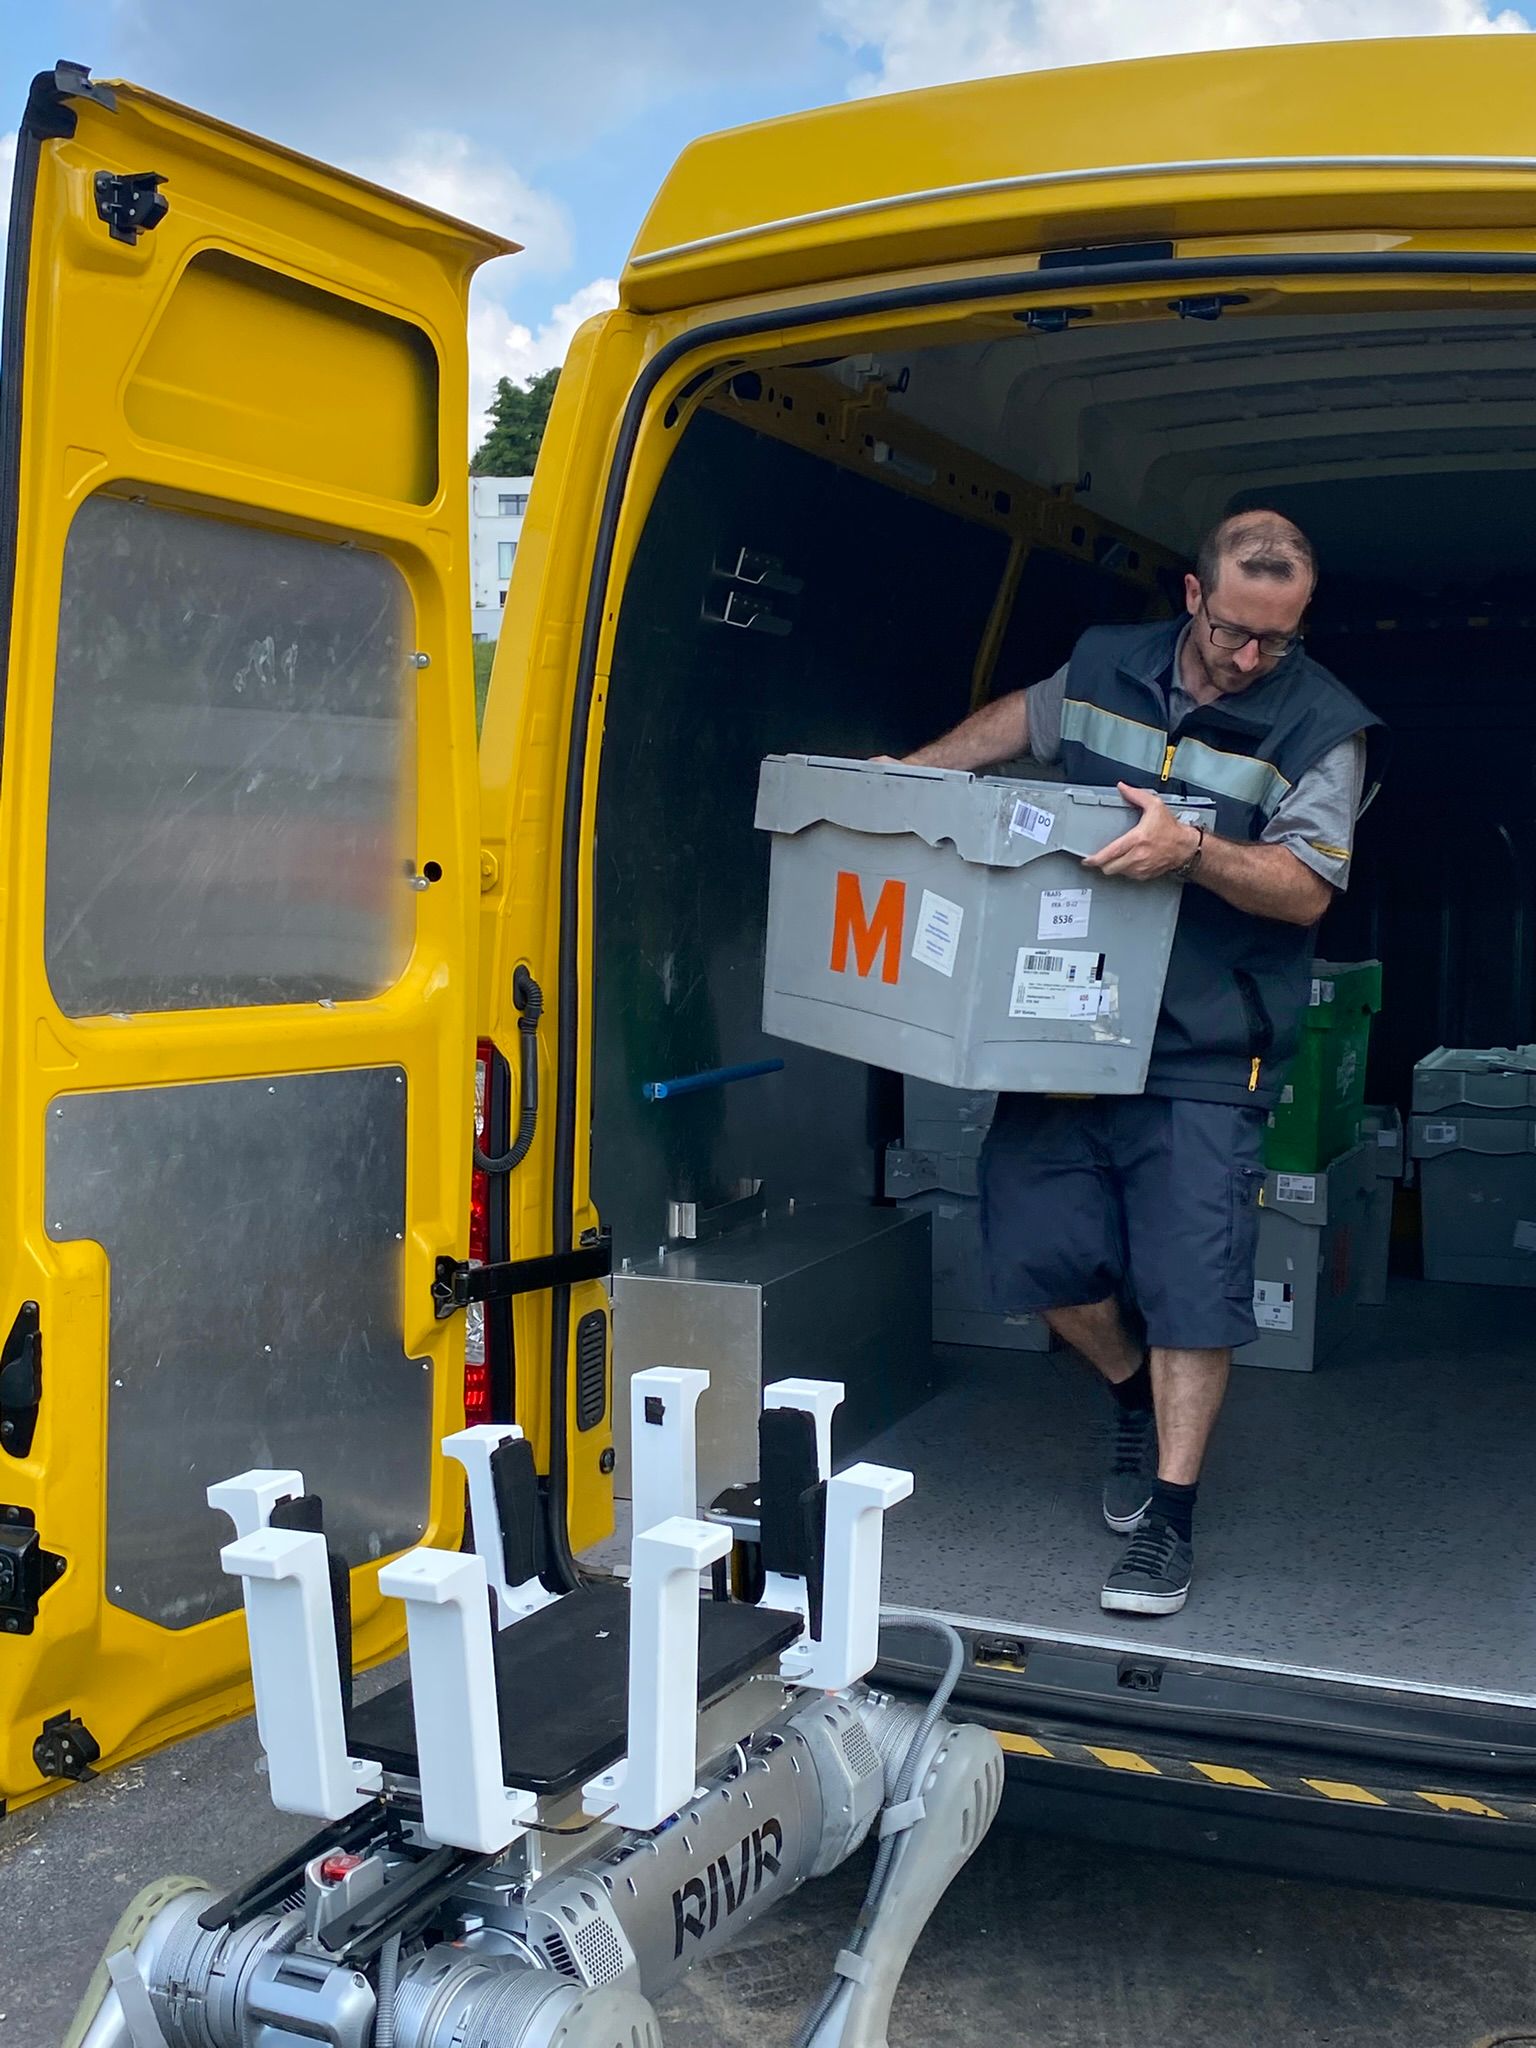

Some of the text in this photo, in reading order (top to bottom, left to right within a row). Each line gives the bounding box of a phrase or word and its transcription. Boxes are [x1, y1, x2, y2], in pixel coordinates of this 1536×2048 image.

[1038, 815, 1051, 827] DO
[830, 870, 906, 985] M
[1052, 914, 1073, 925] 8536
[672, 1817, 783, 1961] RIVR
